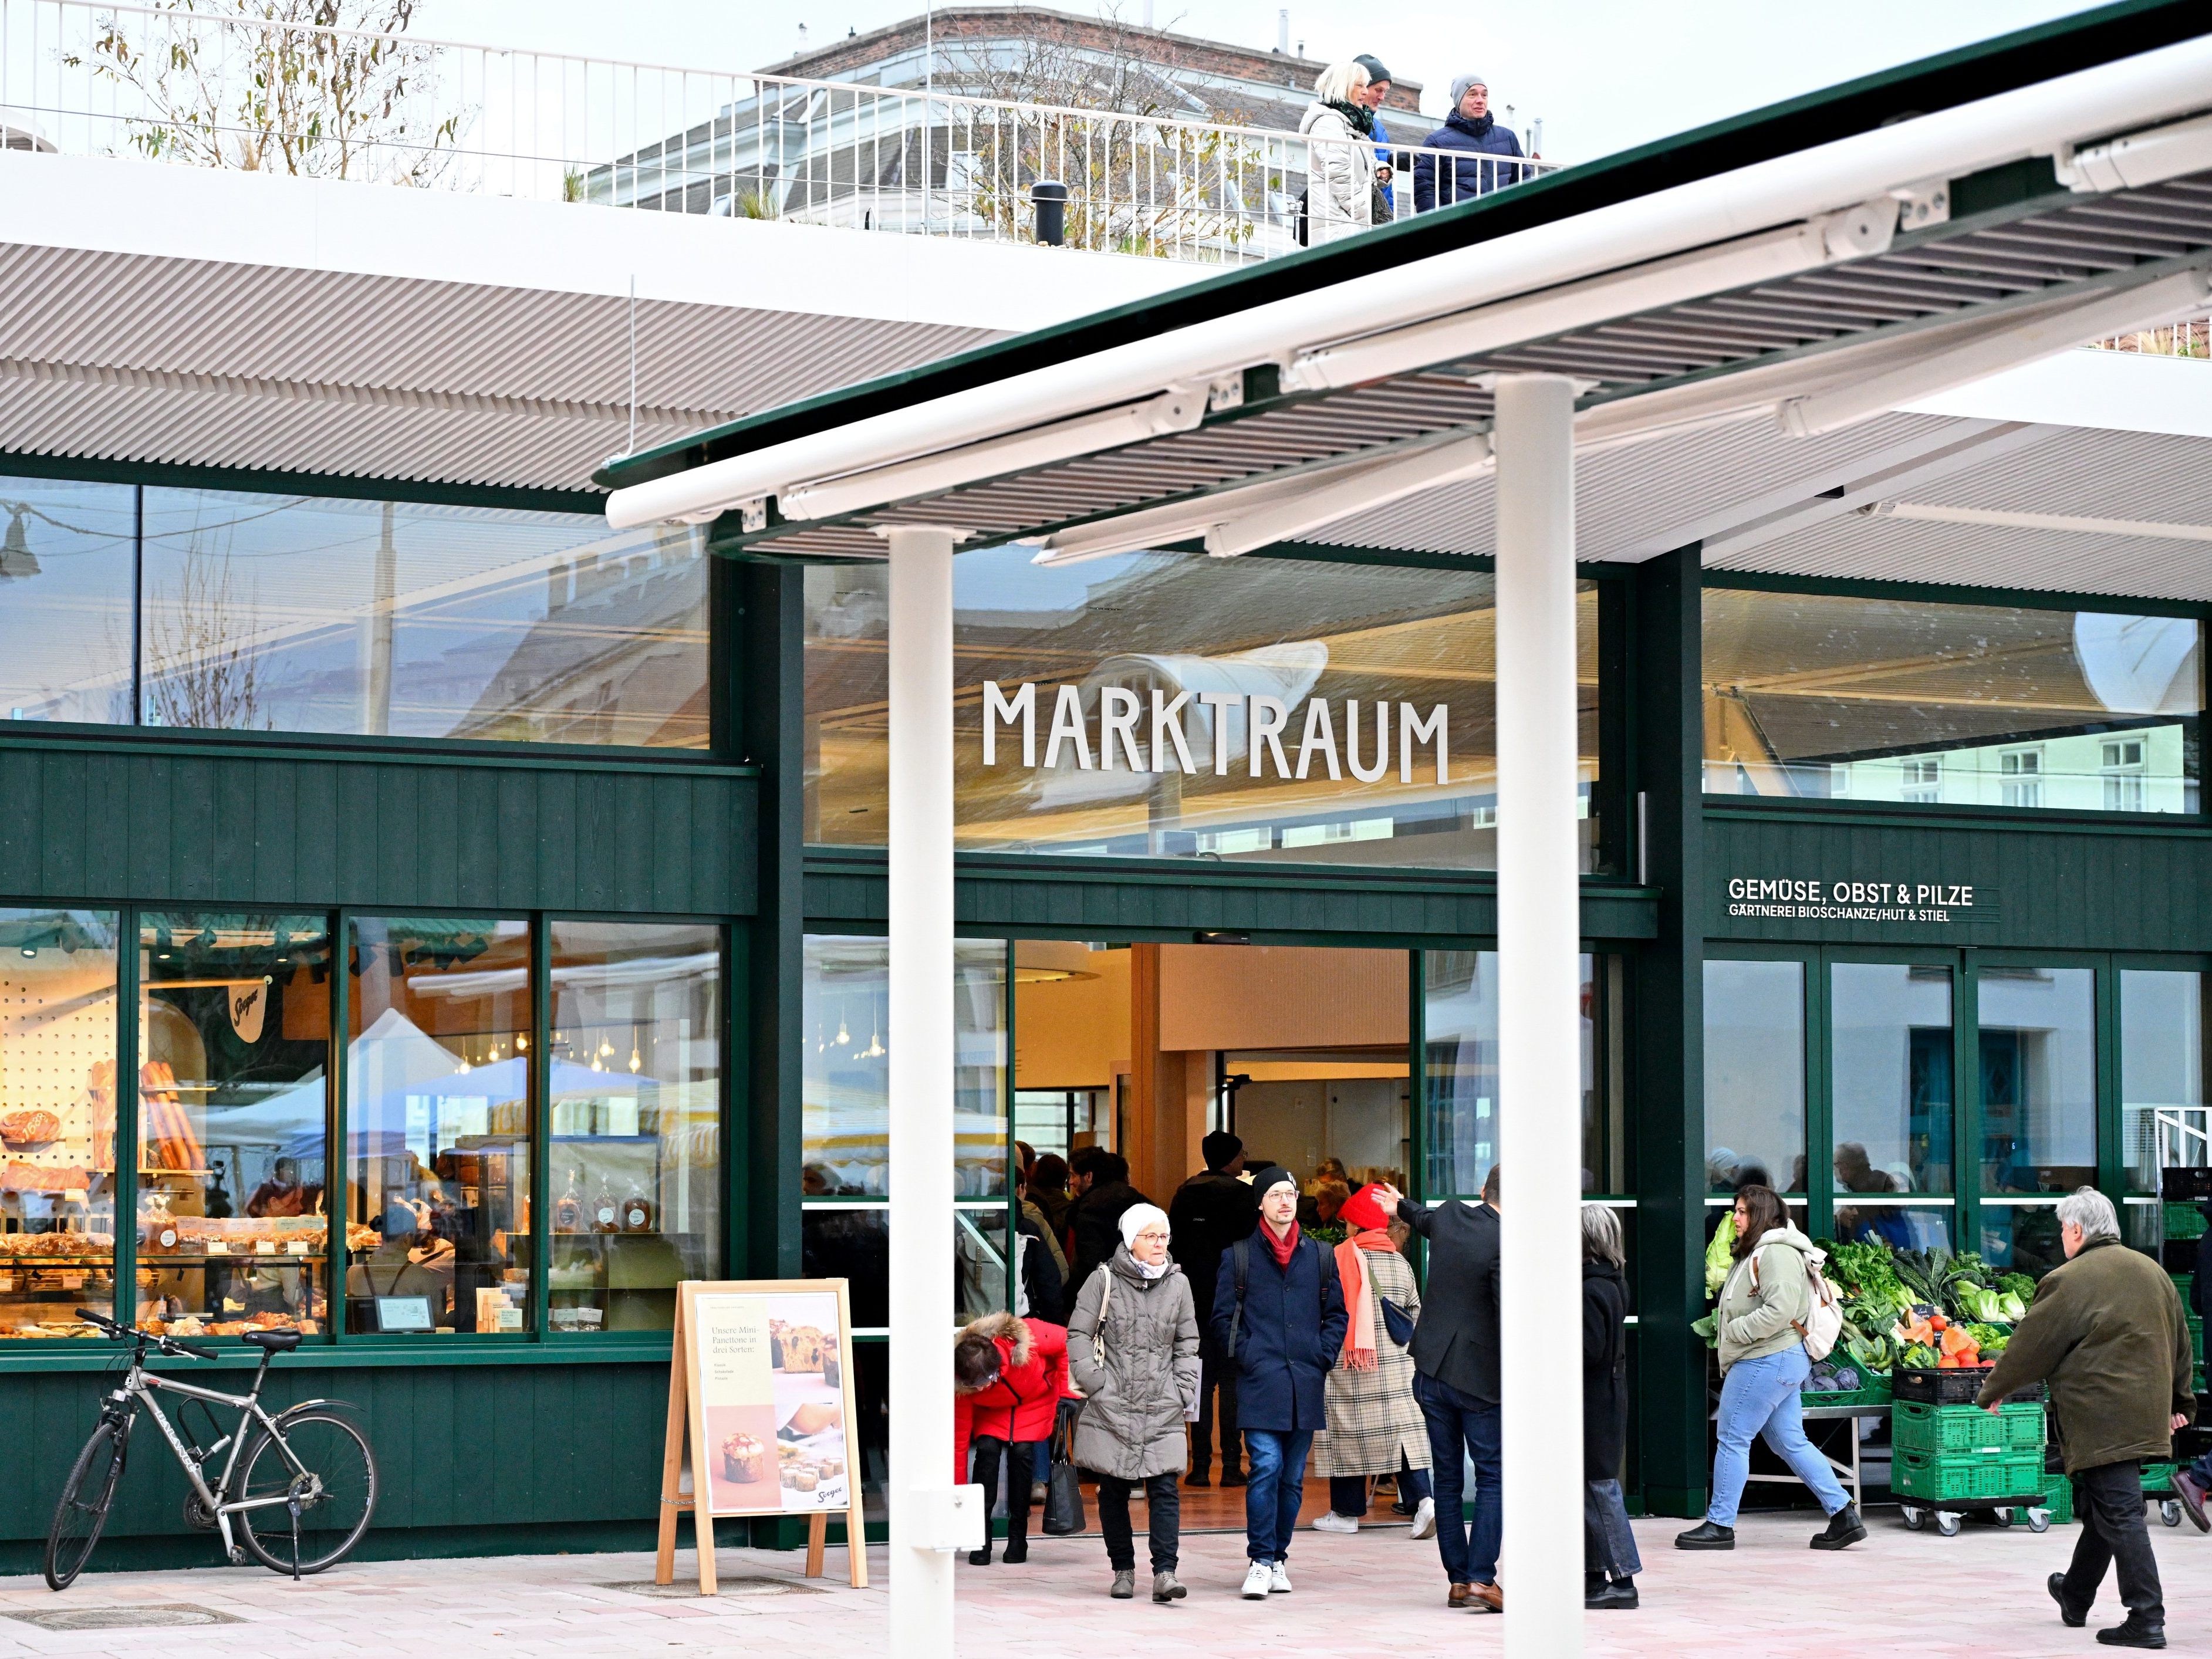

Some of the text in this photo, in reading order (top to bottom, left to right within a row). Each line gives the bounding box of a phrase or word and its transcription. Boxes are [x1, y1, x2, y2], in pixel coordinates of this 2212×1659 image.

[983, 681, 1448, 785] MARKTRAUM
[1728, 879, 1973, 906] GEMÜSE, OBST & PILZE
[1729, 903, 1950, 922] GÄRTNEREI BIOSCHANZE/HUT & STIEL
[818, 1486, 842, 1503] Sorger
